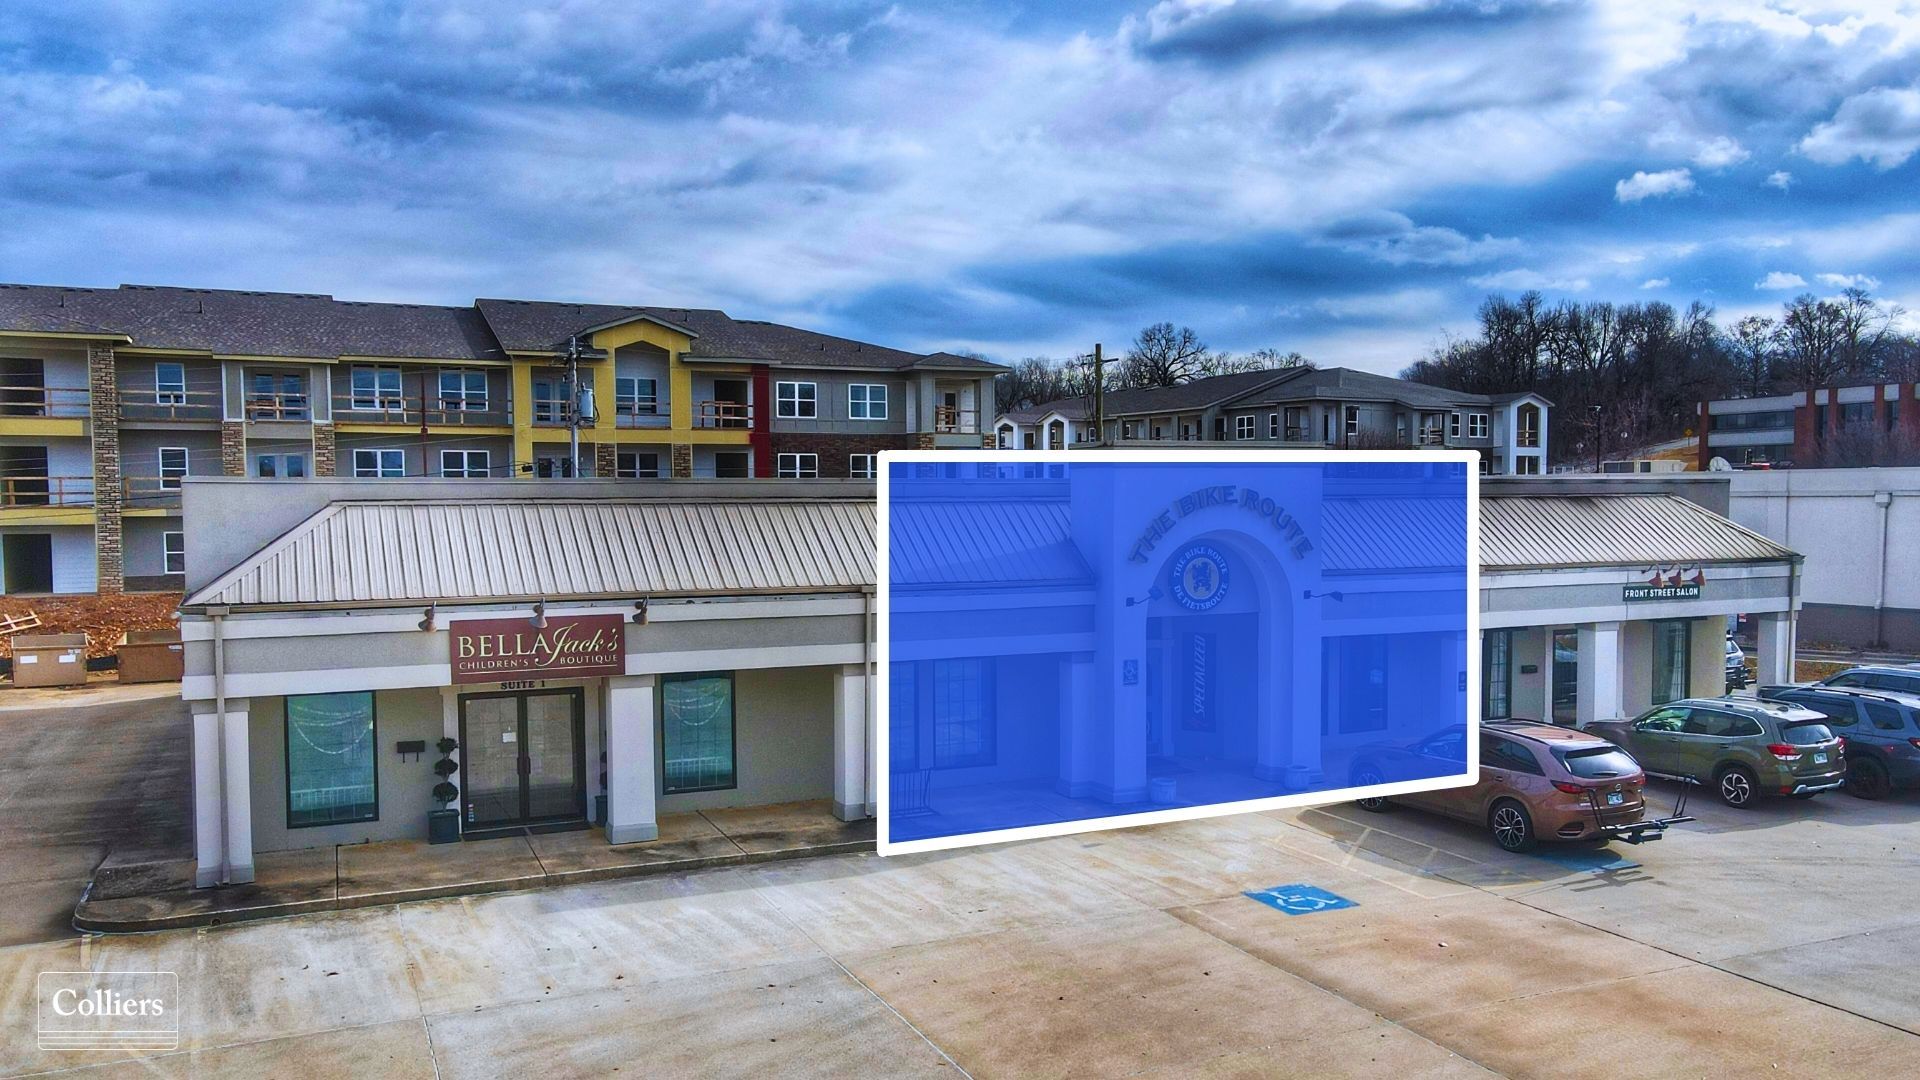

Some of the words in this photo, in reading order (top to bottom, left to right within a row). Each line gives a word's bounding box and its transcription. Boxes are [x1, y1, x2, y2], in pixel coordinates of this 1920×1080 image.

[1127, 509, 1177, 564] THE
[1174, 485, 1237, 518] BIKE
[1239, 487, 1315, 561] ROUTE
[1174, 559, 1186, 577] THE
[1185, 546, 1206, 559] BIKE
[1207, 548, 1228, 575] ROUTE
[1625, 589, 1648, 598] FRONT
[1649, 588, 1675, 597] STREET
[1676, 587, 1699, 596] SALON
[457, 632, 551, 658] BELLA
[535, 622, 619, 666] Jack's
[459, 658, 529, 670] CHILDREN'S
[560, 654, 618, 665] BOUTIQUE
[1193, 634, 1206, 714] SPECIALIZED
[500, 680, 535, 690] SUITE
[541, 680, 546, 688] 1
